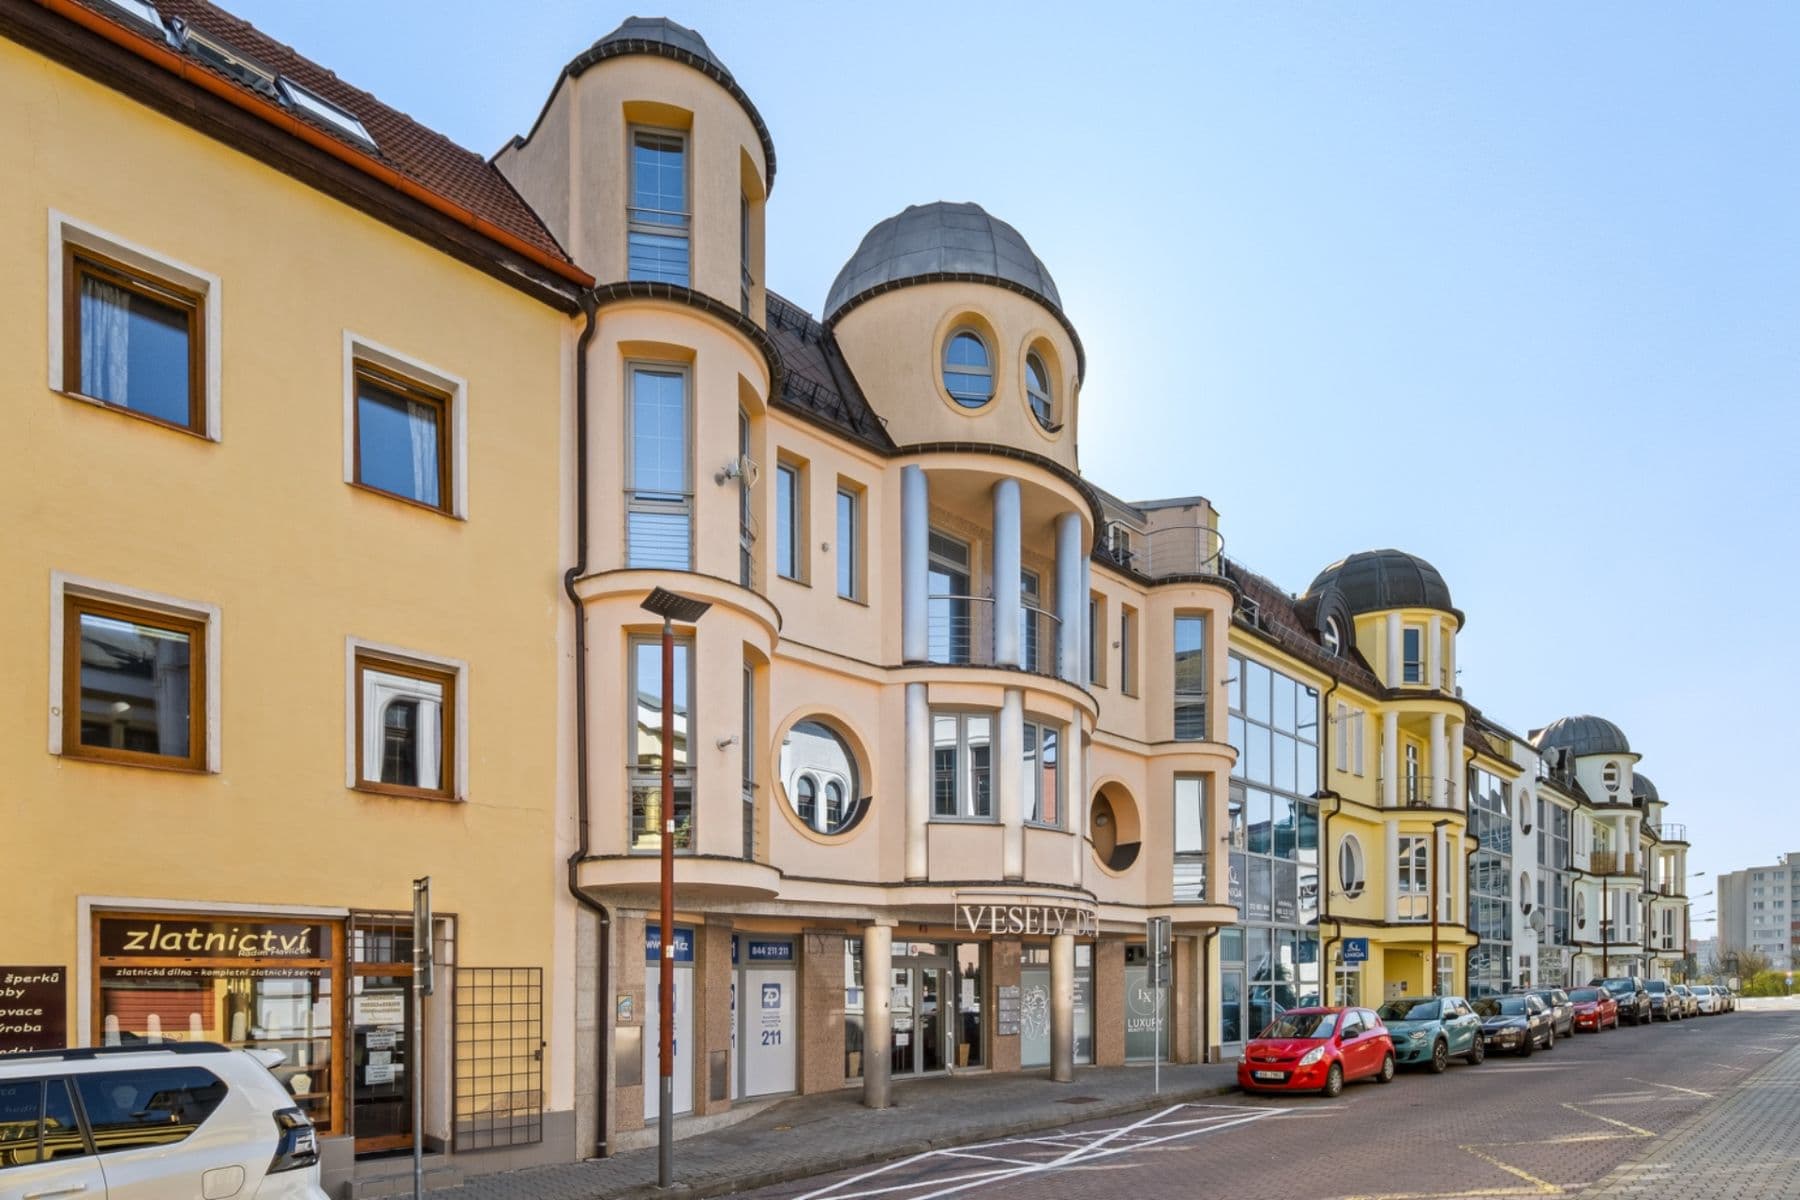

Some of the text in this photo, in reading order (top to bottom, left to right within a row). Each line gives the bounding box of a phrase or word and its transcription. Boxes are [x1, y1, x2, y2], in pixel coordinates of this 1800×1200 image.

[123, 923, 312, 952] zlatnictví
[116, 968, 165, 976] zlatnická
[167, 968, 192, 976] dílna
[201, 968, 249, 977] kompletní
[5, 973, 59, 985] šperků
[0, 987, 26, 999] oby
[0, 1008, 43, 1016] ovace
[761, 1030, 781, 1046] 211
